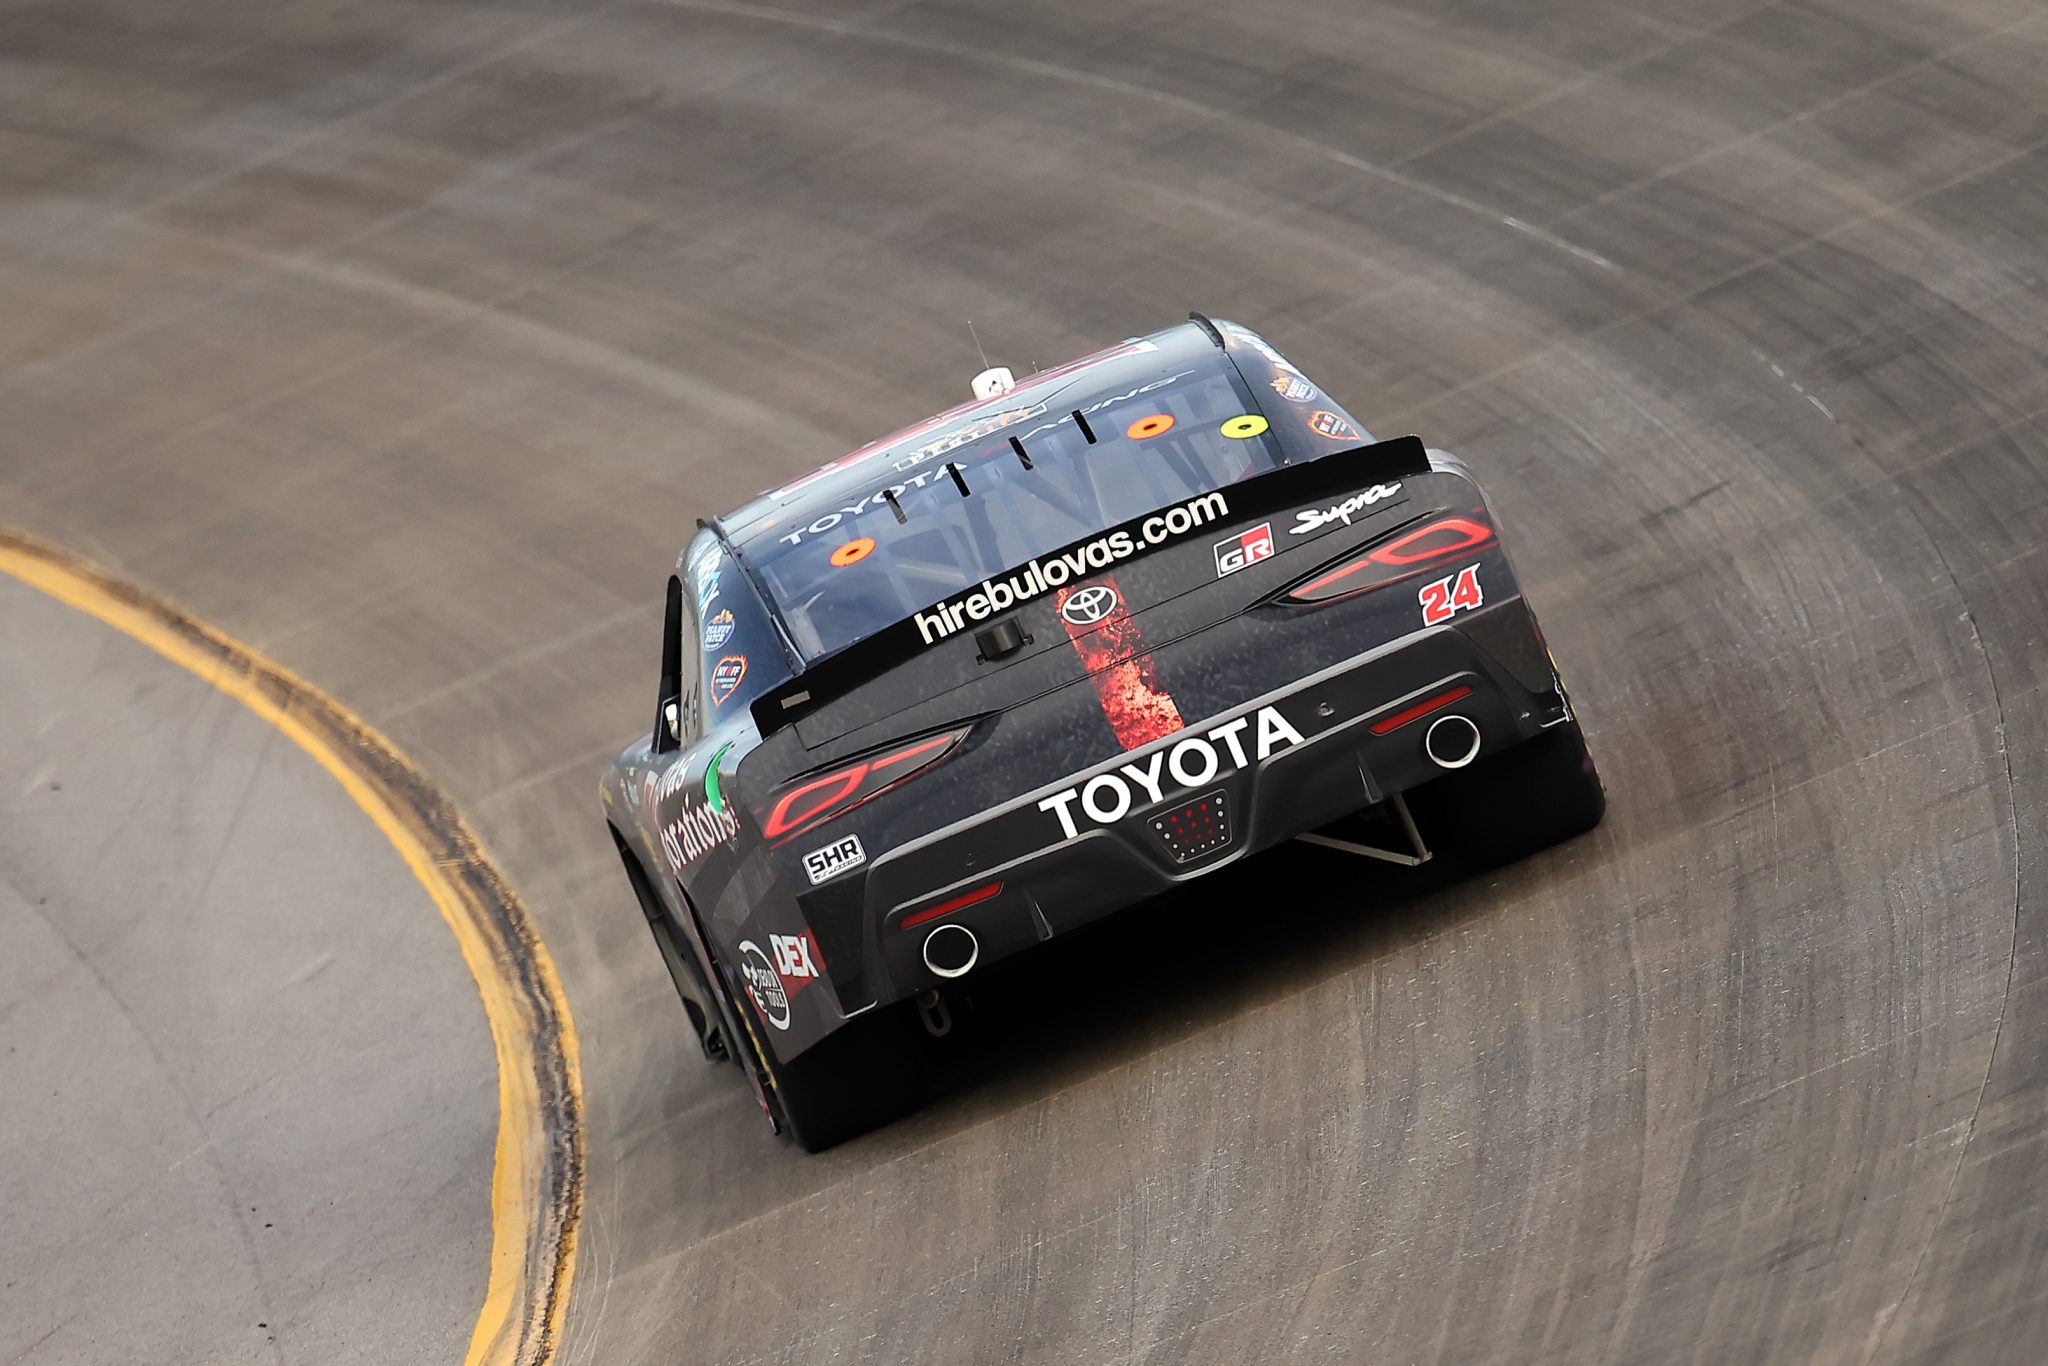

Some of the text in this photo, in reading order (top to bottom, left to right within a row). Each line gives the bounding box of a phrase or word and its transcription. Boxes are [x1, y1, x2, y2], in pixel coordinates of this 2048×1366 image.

[779, 462, 968, 546] TOYOTA
[1018, 370, 1196, 442] ACING
[1288, 482, 1402, 535] Supra
[913, 492, 1229, 644] hirebulovas.com
[1418, 562, 1484, 627] 24
[1038, 705, 1306, 839] TOYOTA
[807, 839, 860, 876] SHR
[768, 933, 820, 978] DEX
